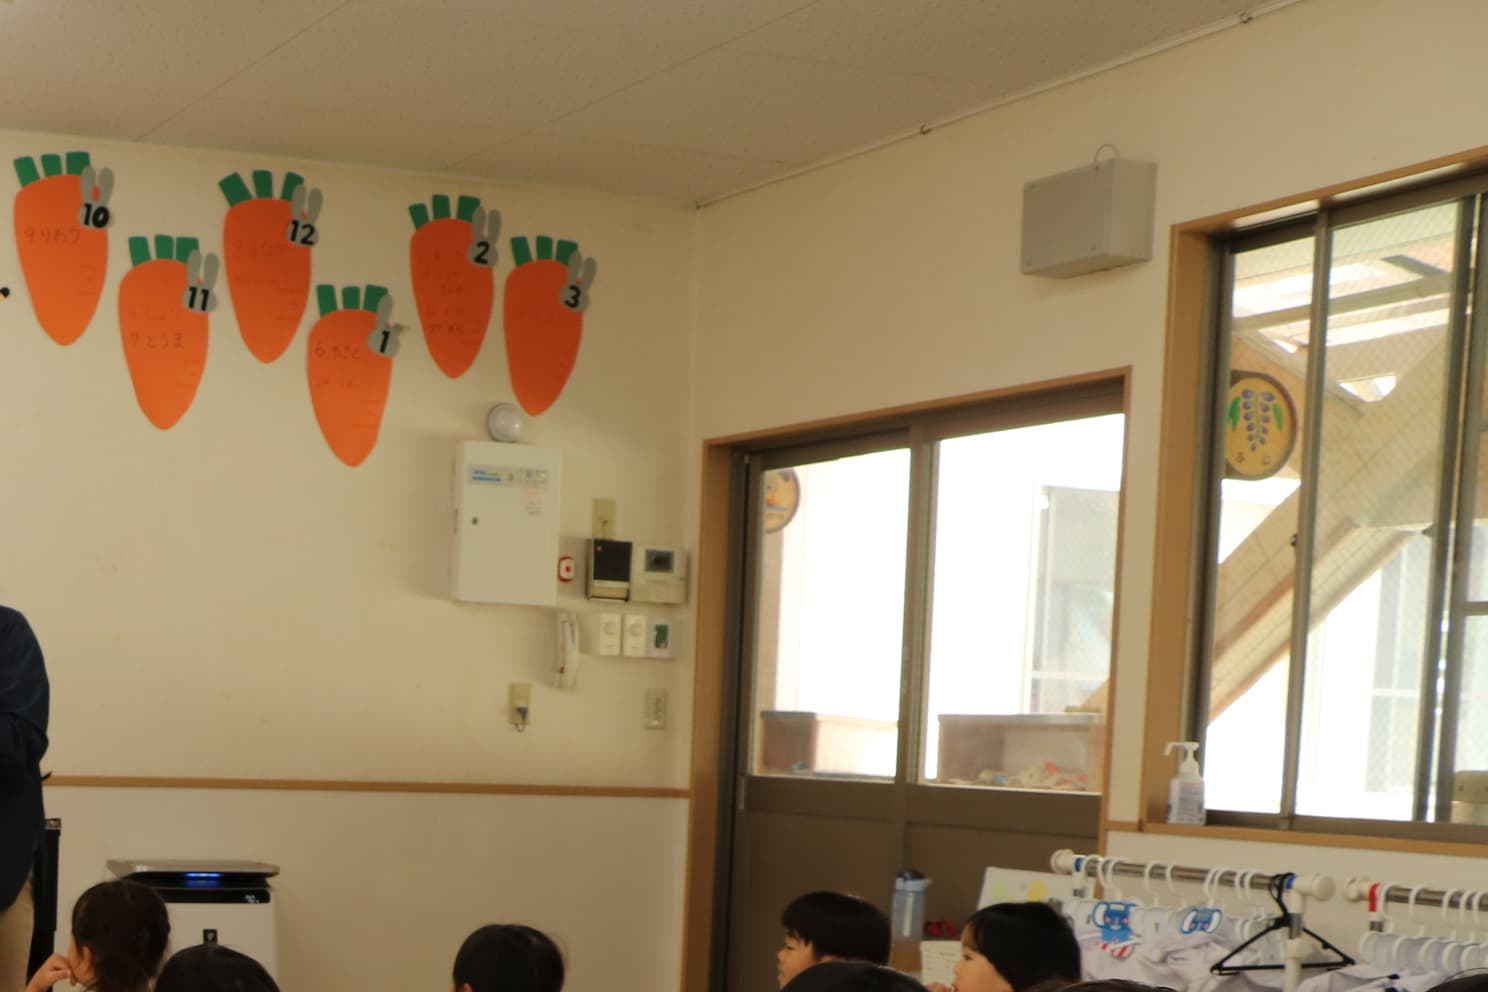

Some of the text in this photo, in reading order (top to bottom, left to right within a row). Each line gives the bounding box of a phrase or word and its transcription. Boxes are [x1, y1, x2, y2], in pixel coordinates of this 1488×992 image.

[83, 202, 111, 229] 10
[289, 219, 316, 247] 12
[472, 240, 491, 266] 2
[187, 285, 211, 312] 11
[563, 284, 582, 309] 3
[378, 329, 391, 355] 1
